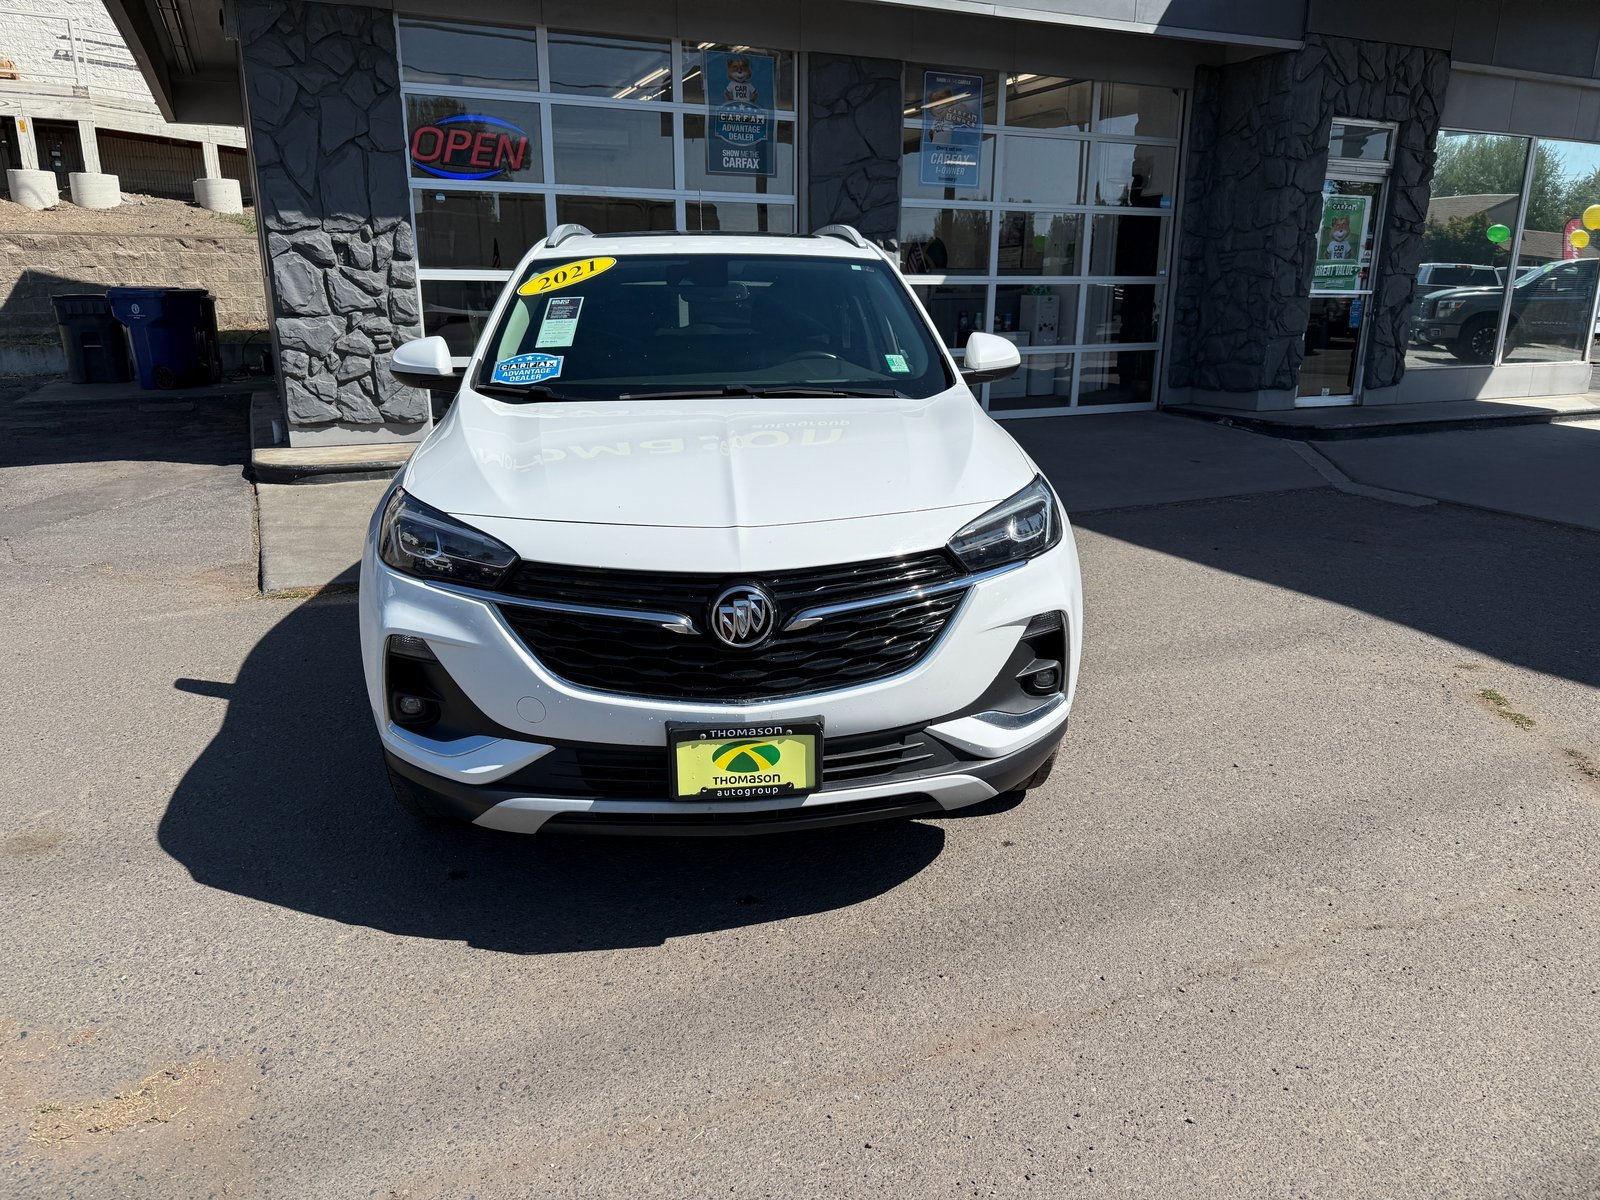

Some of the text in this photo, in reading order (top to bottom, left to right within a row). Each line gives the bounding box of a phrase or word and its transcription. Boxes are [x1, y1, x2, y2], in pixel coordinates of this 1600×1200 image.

[721, 113, 764, 123] CARFAX
[722, 124, 760, 133] ADVANTAGE
[728, 133, 755, 141] DEALER
[411, 126, 527, 171] OPEN
[722, 149, 740, 157] SHOW
[723, 158, 759, 169] CARFAX
[538, 260, 598, 291] 2021
[500, 360, 557, 371] CARFAX
[502, 367, 551, 377] ADVANTAGE
[509, 374, 542, 382] DEALER
[716, 787, 779, 797] autogroup
